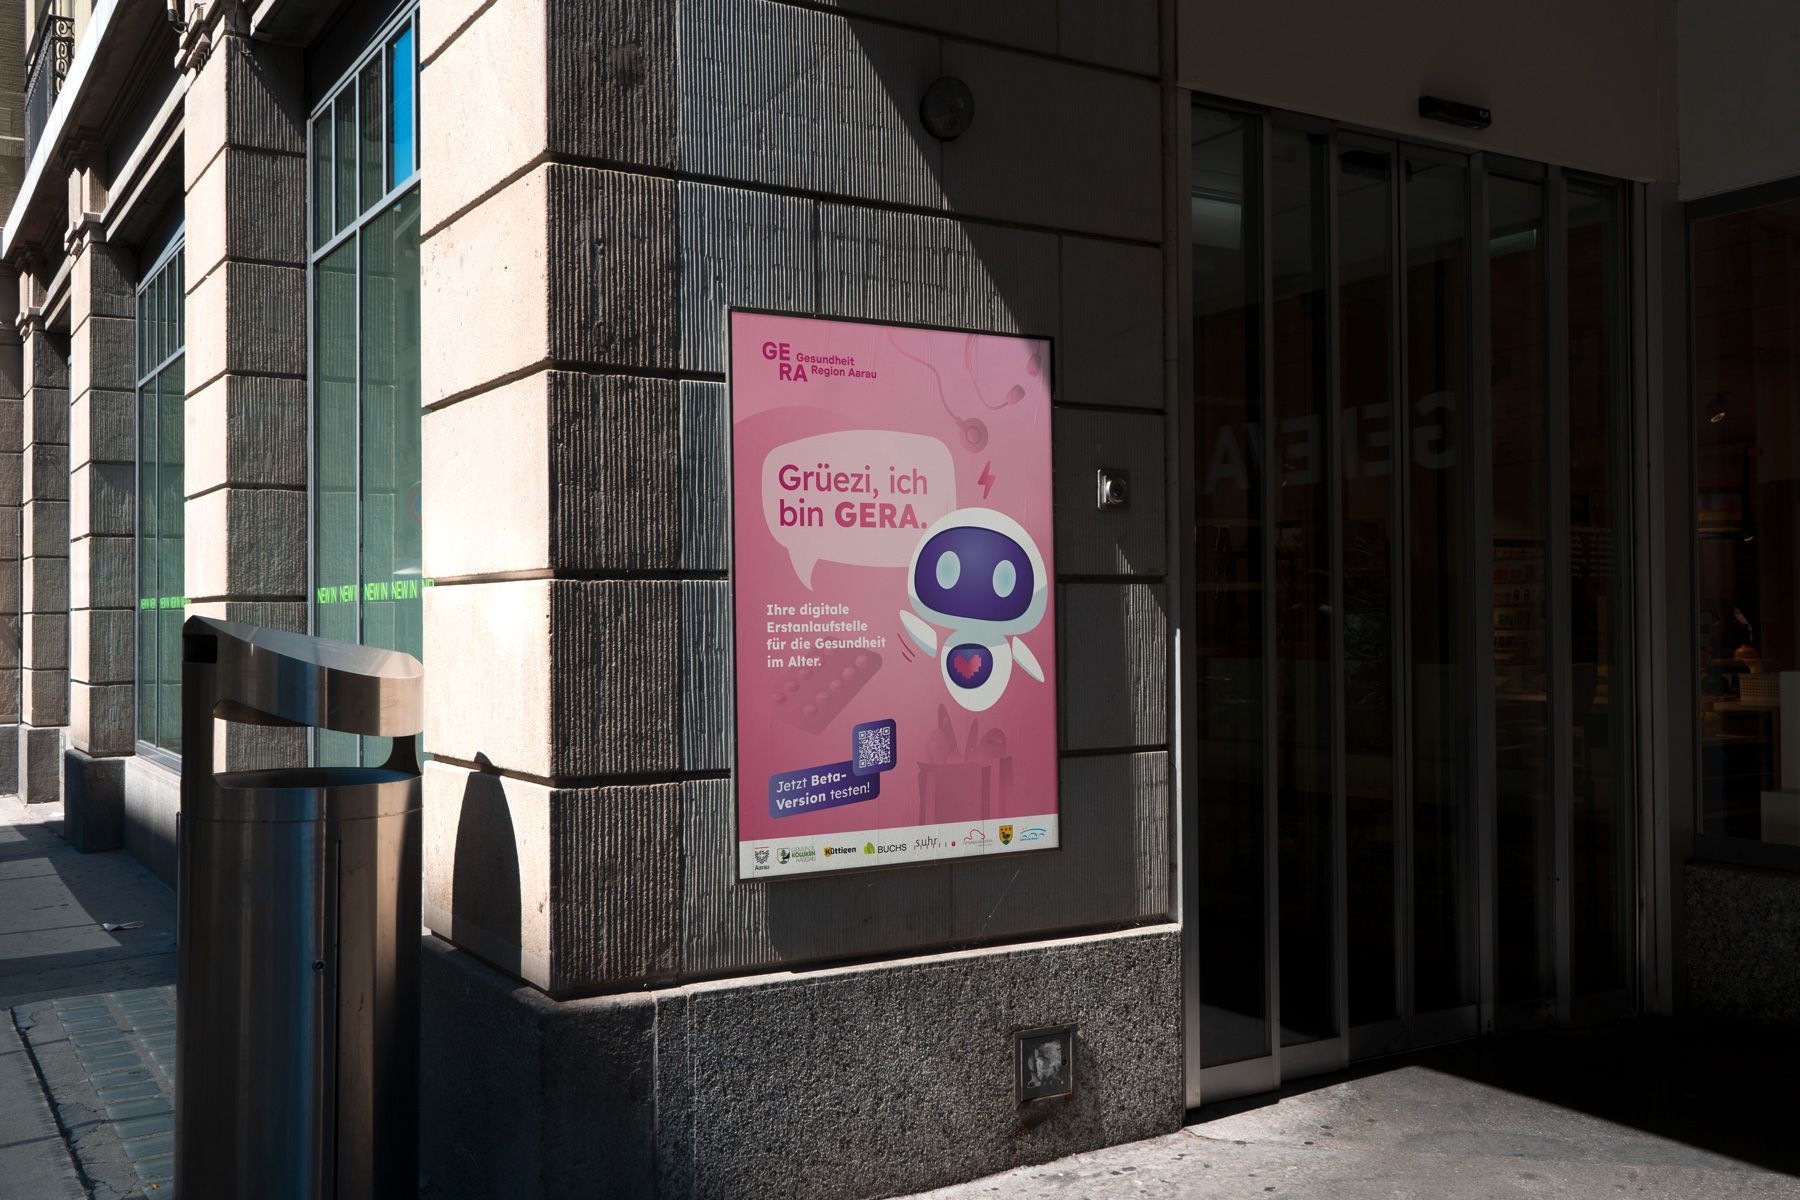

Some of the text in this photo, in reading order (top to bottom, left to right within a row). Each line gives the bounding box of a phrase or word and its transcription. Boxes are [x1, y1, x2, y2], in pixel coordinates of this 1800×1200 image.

[762, 341, 791, 361] GE
[796, 352, 855, 366] Gesundheit
[779, 362, 808, 382] RA
[811, 365, 877, 379] Region Aarau
[778, 462, 928, 499] Grüezi, ich
[779, 498, 928, 529] bin GERA.
[364, 582, 379, 601] NEW
[391, 580, 409, 599] NEW
[766, 603, 850, 618] Ihre digitale
[766, 620, 868, 633] Erstanlaufstelle
[766, 636, 886, 650] für die Gesundheit
[767, 655, 822, 668] im Alter.
[776, 772, 847, 793] Jetzt Beta-
[776, 782, 871, 811] Version testen!
[825, 846, 857, 855] Küttigen
[877, 843, 907, 853] BUCHS
